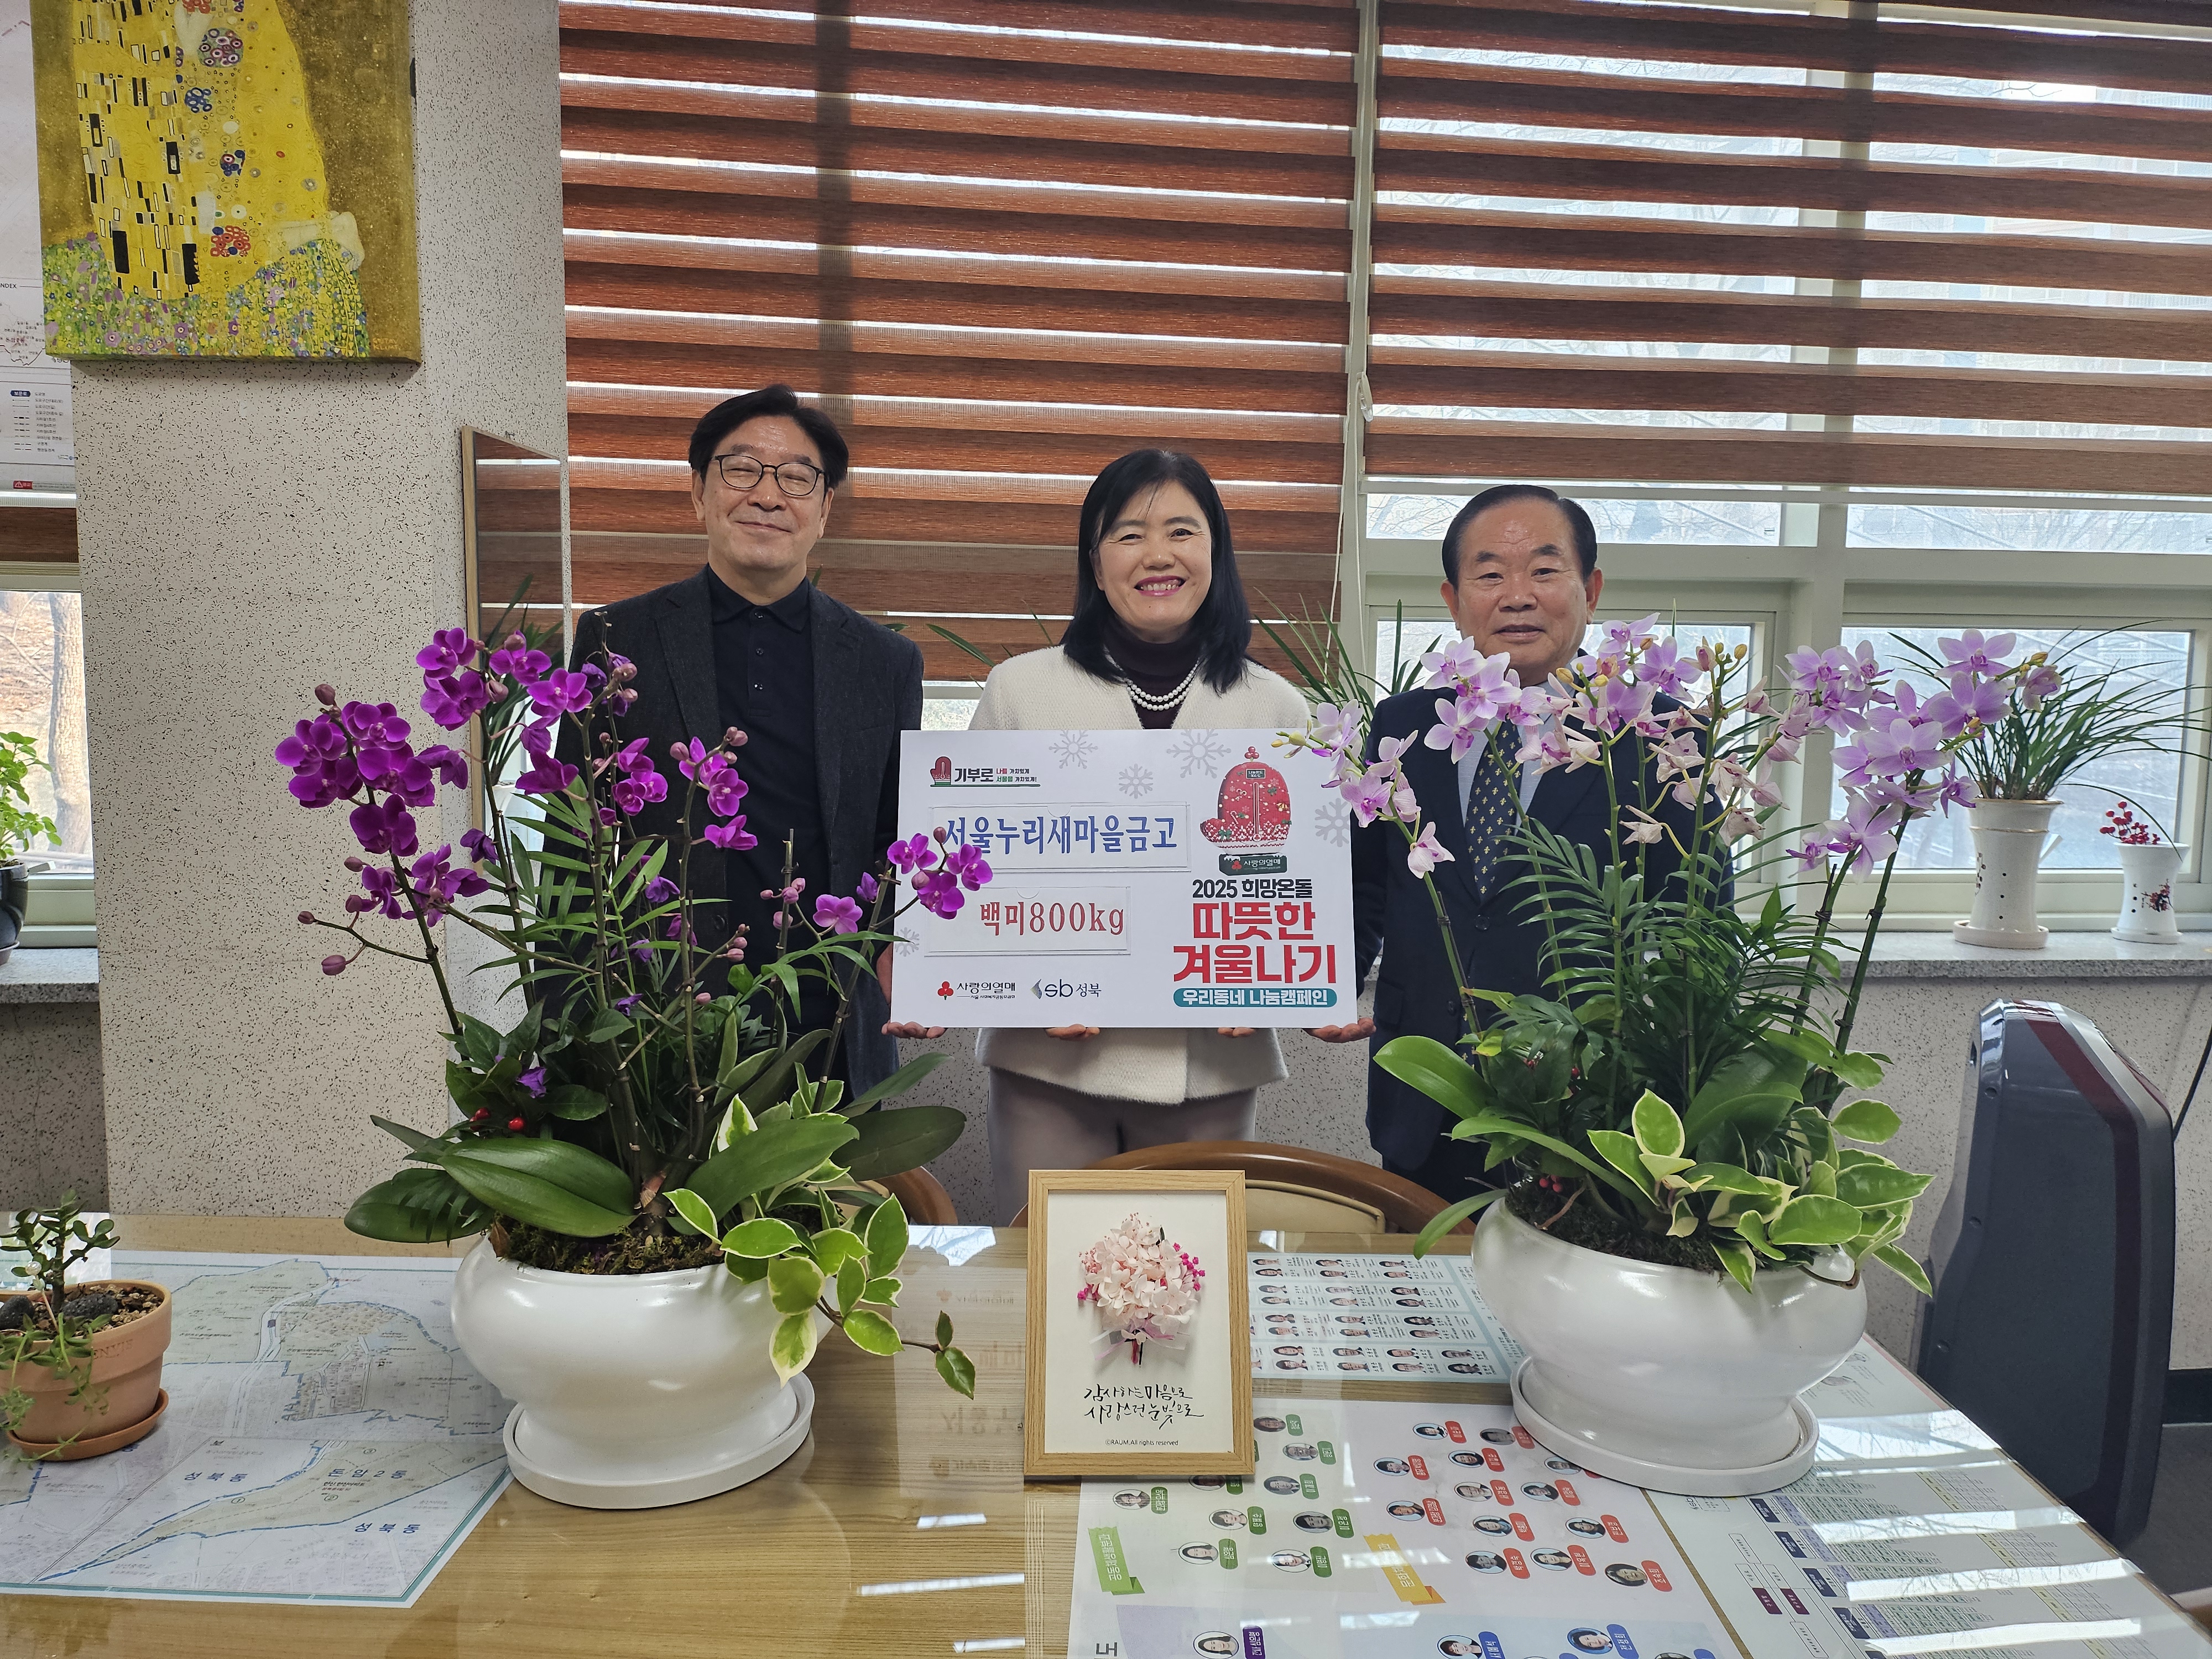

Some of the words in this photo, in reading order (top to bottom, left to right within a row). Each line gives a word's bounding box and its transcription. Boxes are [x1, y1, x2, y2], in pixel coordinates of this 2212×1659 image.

[954, 768, 994, 782] 기부로
[943, 815, 1177, 855] 서울누리새마을금고
[1244, 859, 1281, 867] 사랑의열매
[1192, 879, 1238, 898] 2025
[1241, 879, 1313, 899] 희망온돌
[980, 901, 1124, 936] 백미800kg
[1193, 901, 1316, 940] 따뜻한
[1173, 945, 1337, 984] 겨울나기
[956, 982, 1016, 994] 사랑의열매
[1076, 983, 1102, 998] 성북
[1183, 989, 1244, 1005] 우리동네
[1250, 989, 1328, 1005] 나눔캠페인
[1084, 1384, 1144, 1401] 감사하는
[1145, 1384, 1193, 1401] 마음으로
[1084, 1402, 1145, 1424] 사랑스런
[1148, 1400, 1204, 1430] 눈빛으로
[1156, 1500, 1166, 1511] 분과장
[354, 1522, 421, 1534] 성북동
[1099, 1533, 1121, 1580] 공동체생활분과
[1223, 1547, 1234, 1559] 심은영
[1378, 1543, 1415, 1587] 문화체과
[1510, 1556, 1524, 1571] 박경숙
[1649, 1569, 1666, 1584] 조숙희
[1248, 1631, 1261, 1646] 심은영
[1096, 1642, 1117, 1659] 도
[1251, 1647, 1262, 1655] 간사
